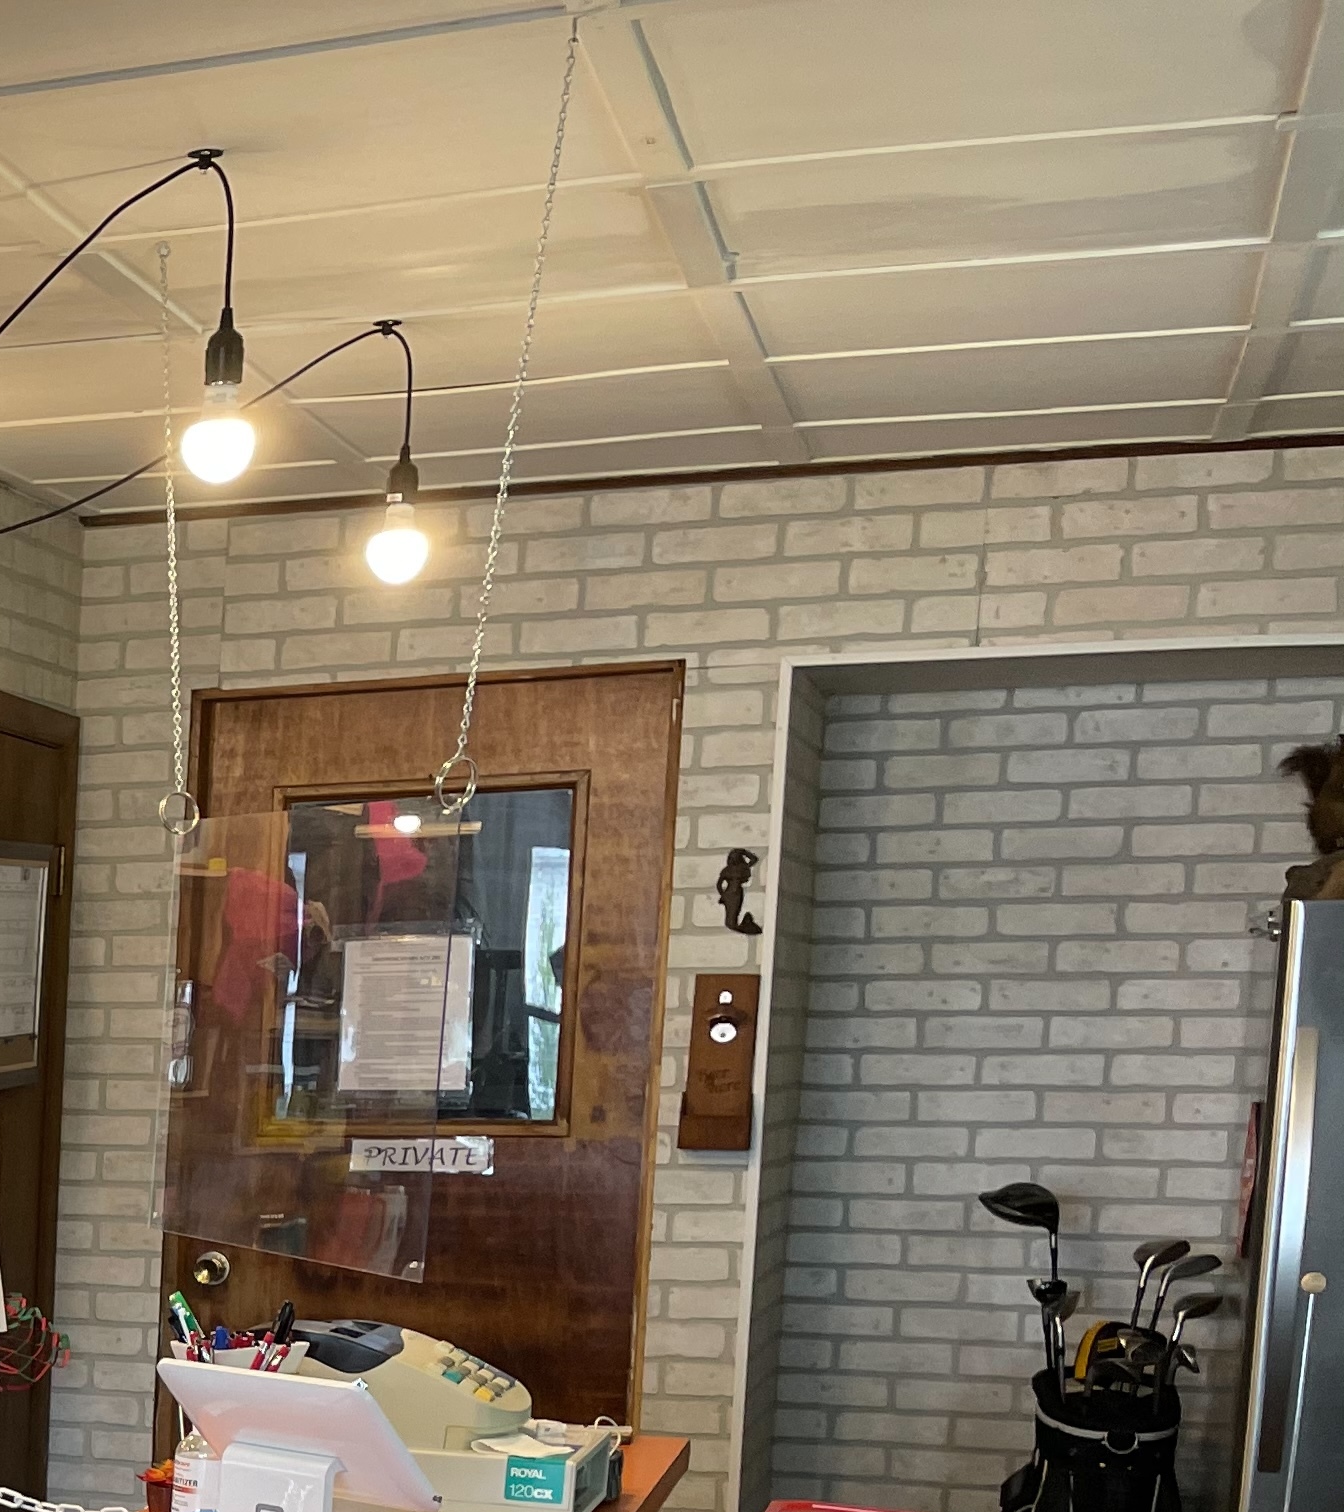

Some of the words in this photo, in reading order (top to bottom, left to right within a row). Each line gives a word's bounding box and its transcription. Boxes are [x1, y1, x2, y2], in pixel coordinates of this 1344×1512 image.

[363, 1145, 481, 1168] PRIVATE
[509, 1466, 547, 1481] ROYAL
[509, 1483, 554, 1500] 120CX
